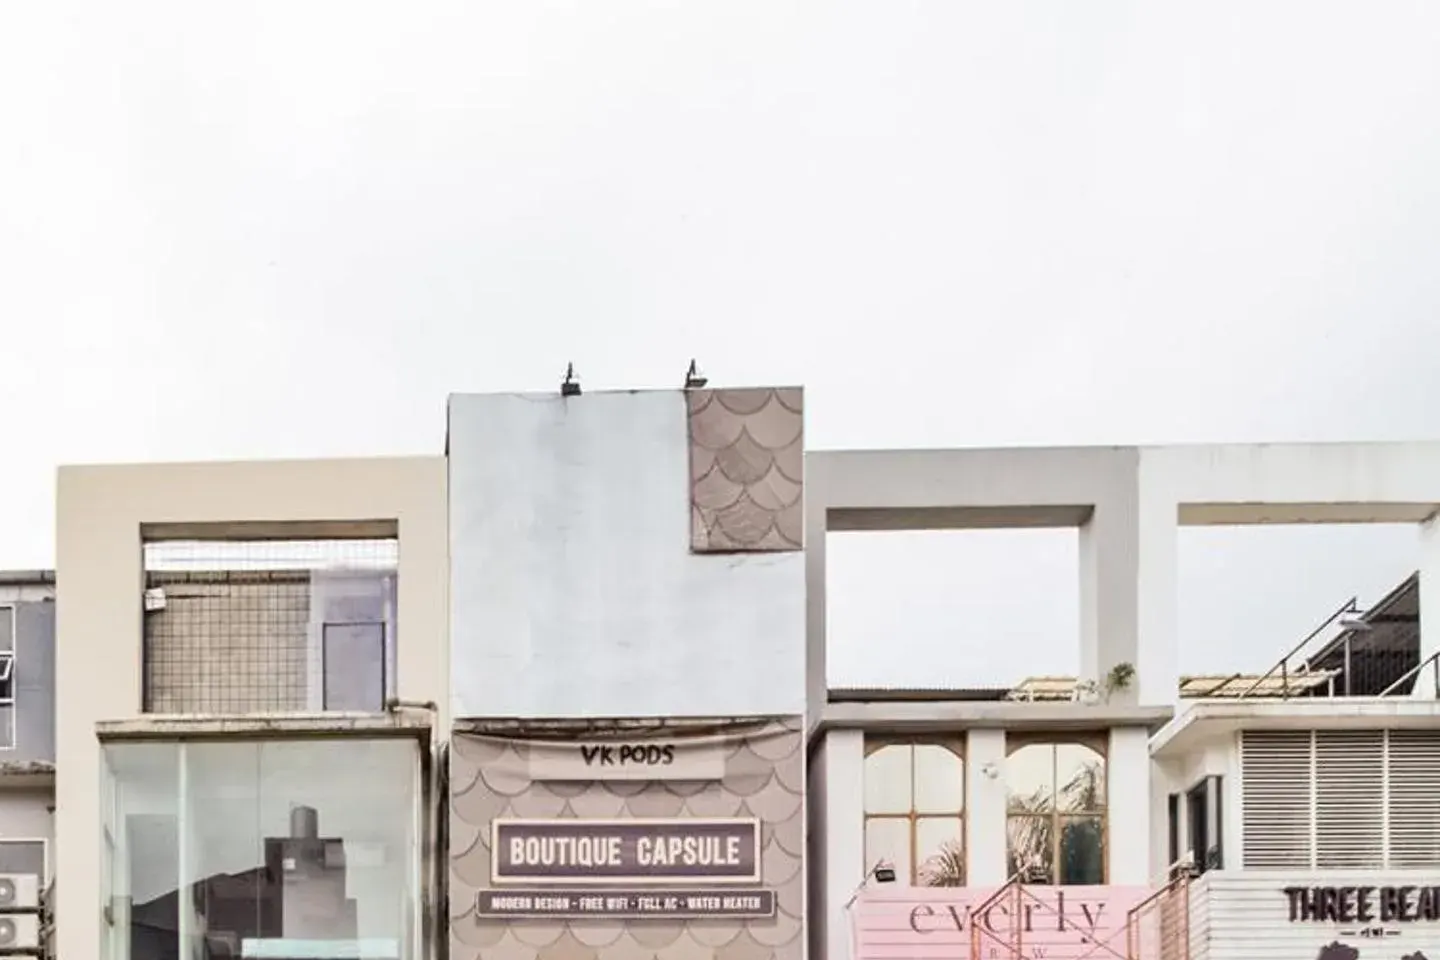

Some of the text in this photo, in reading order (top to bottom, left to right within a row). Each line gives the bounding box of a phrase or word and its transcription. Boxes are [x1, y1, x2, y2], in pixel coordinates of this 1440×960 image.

[581, 745, 675, 766] VK PODS
[509, 836, 740, 866] BOUTIQUE CAPSULE
[579, 897, 603, 909] FREE
[1282, 885, 1375, 922] THREE
